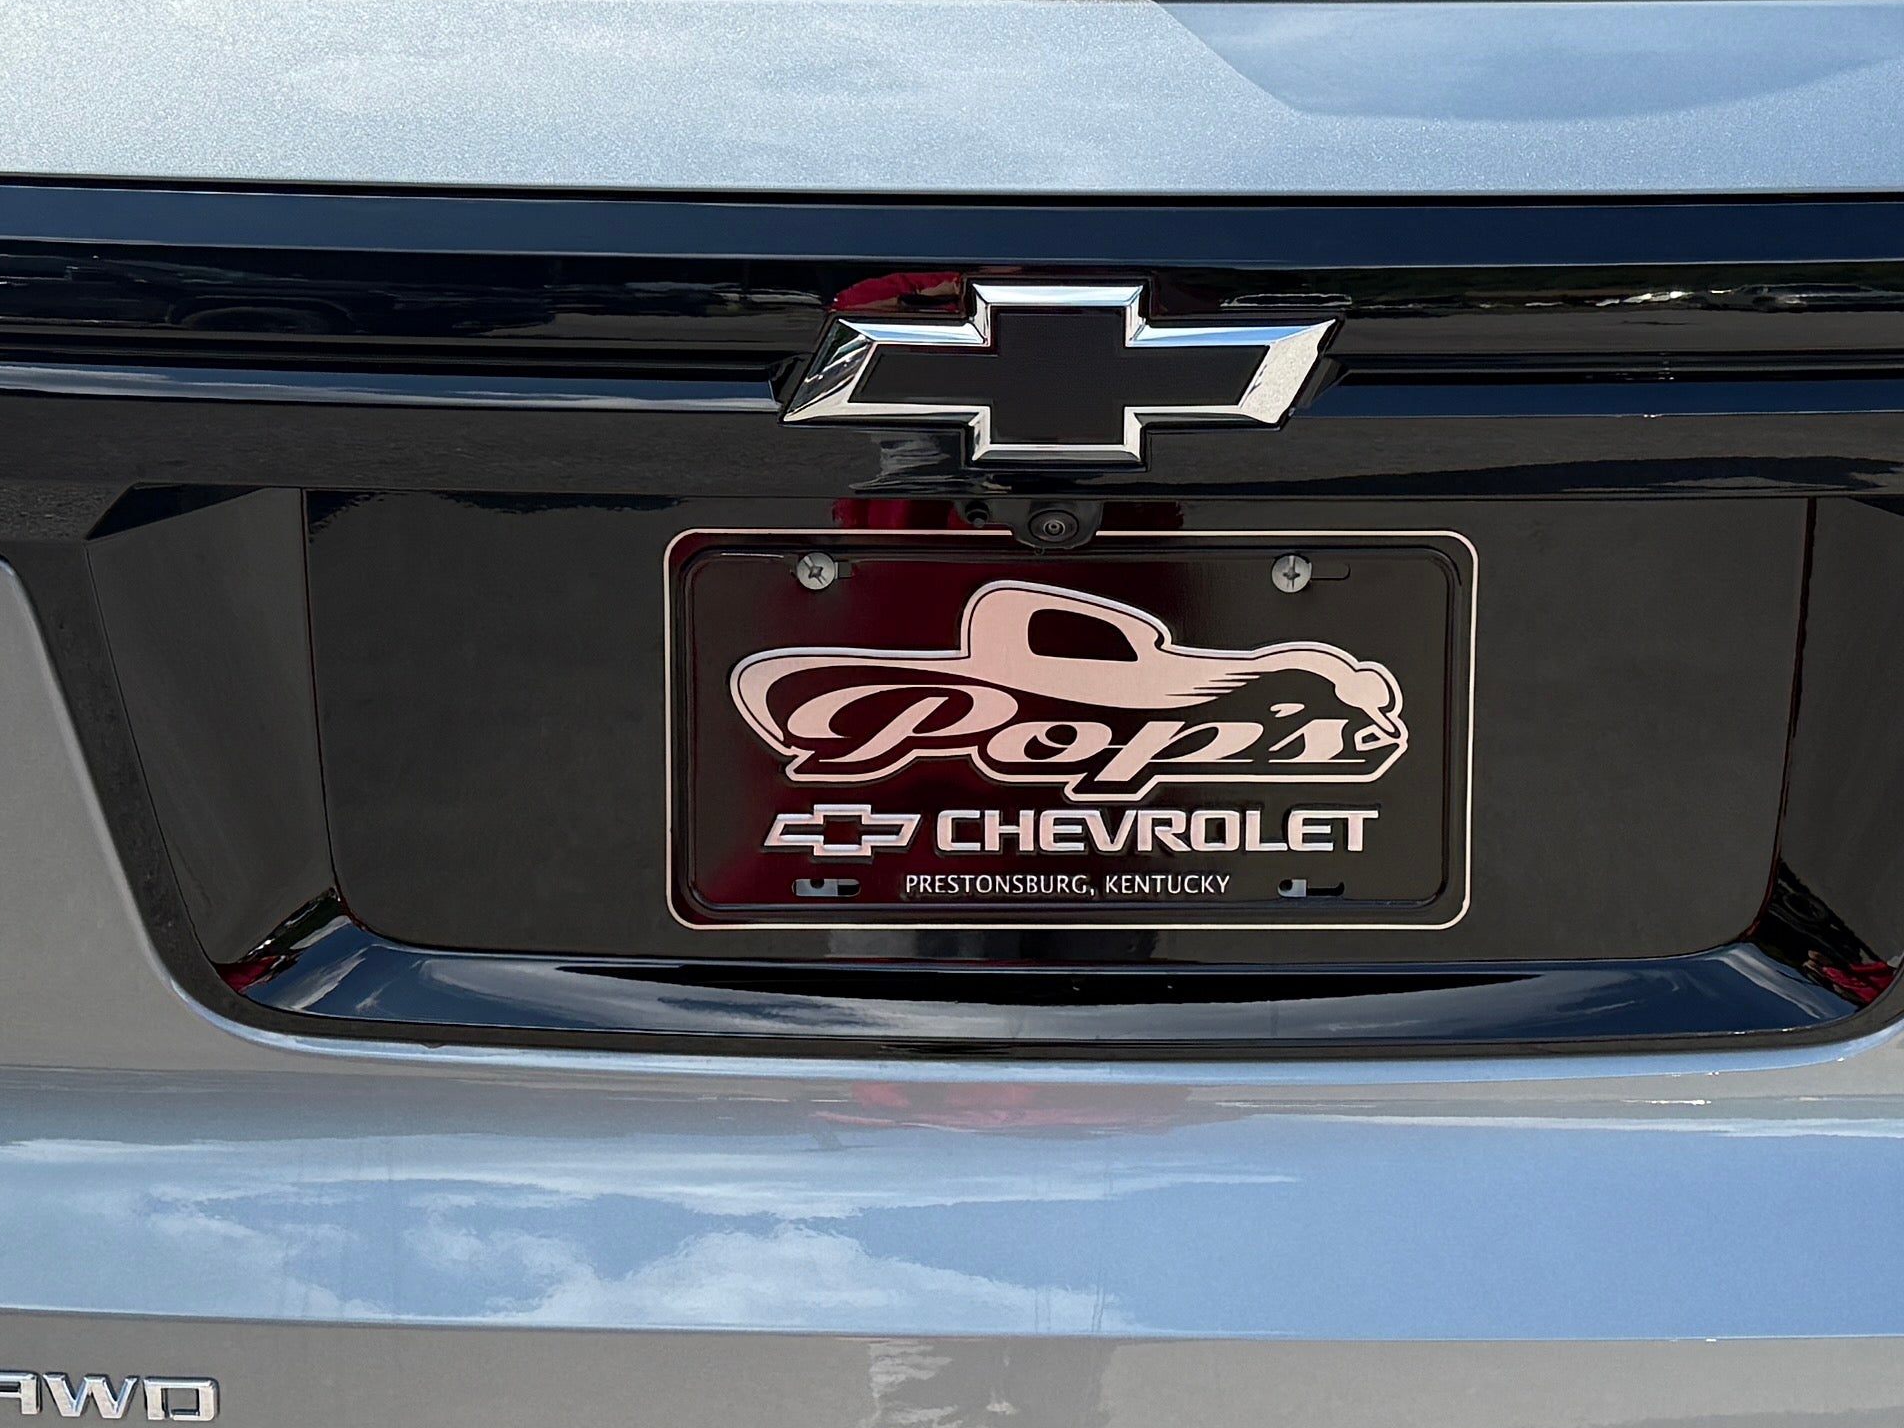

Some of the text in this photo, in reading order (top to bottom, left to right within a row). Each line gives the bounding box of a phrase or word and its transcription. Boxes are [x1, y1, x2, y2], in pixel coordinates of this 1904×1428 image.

[785, 683, 1368, 784] Pop's
[935, 808, 1381, 854] CHEVROLET
[903, 873, 1231, 897] PRESTONSBURG, KENTUCKY
